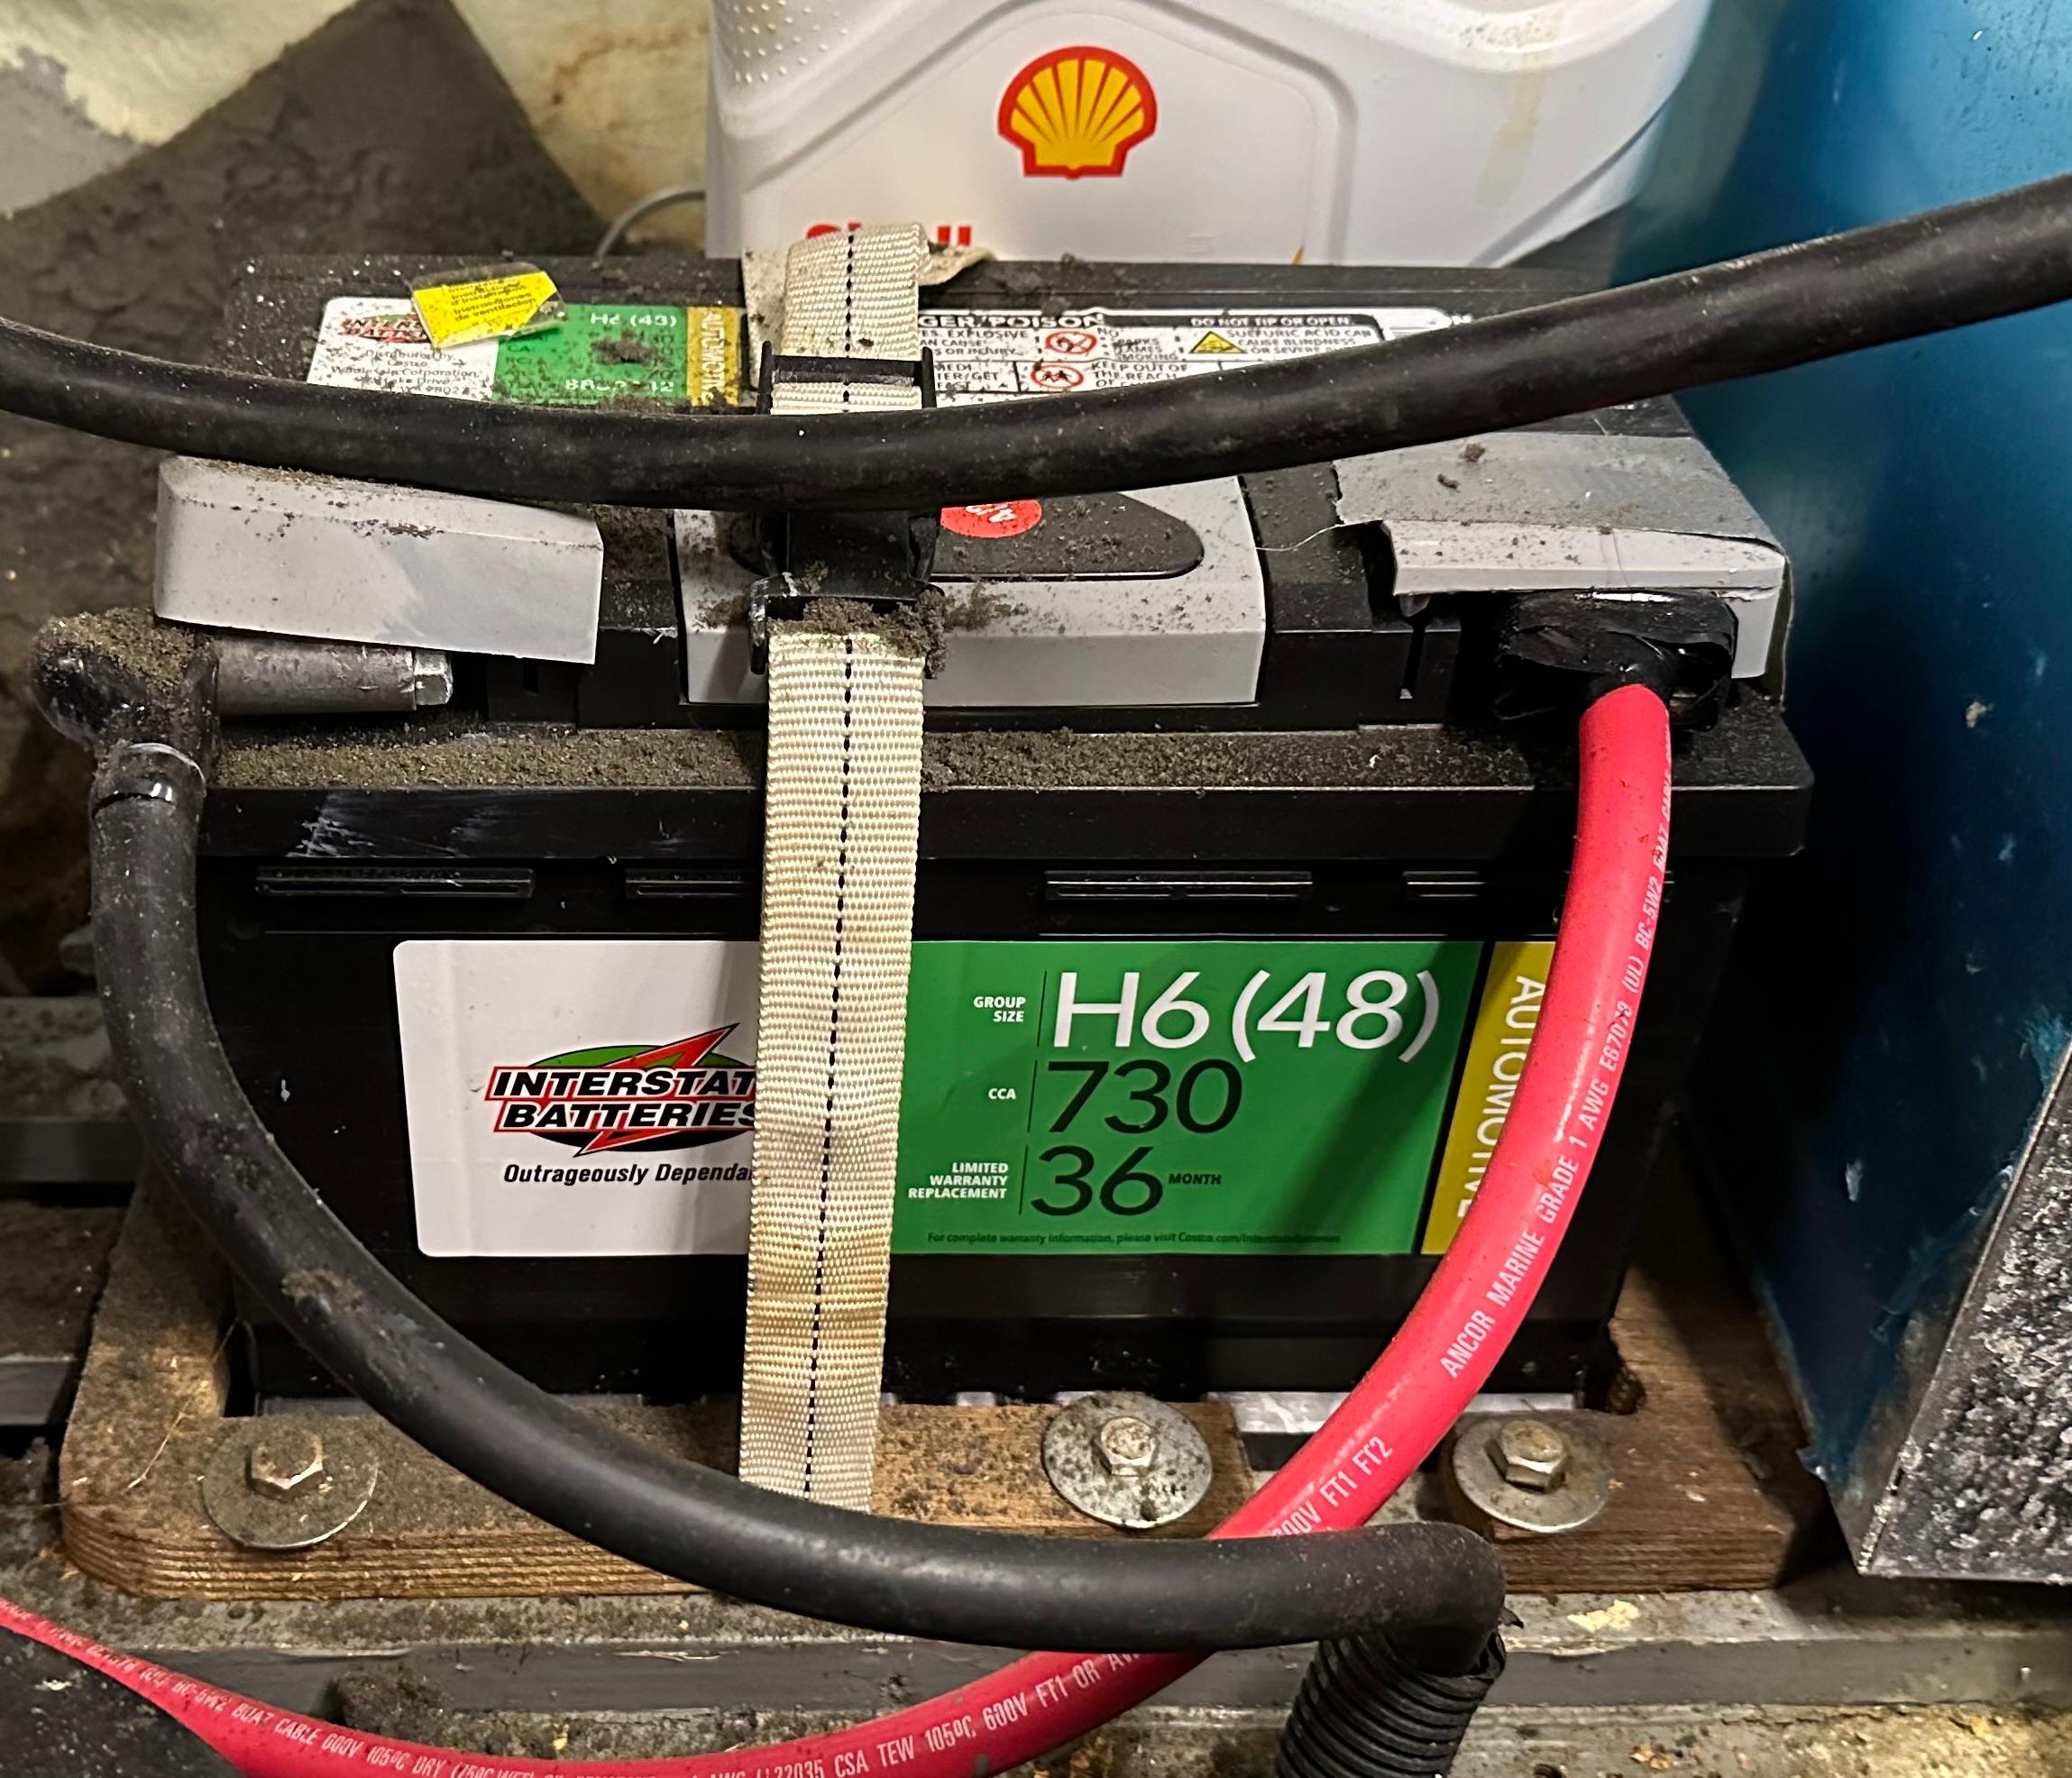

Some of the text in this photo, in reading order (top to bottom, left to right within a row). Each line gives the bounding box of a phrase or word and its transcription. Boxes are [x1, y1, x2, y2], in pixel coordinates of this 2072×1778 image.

[919, 314, 1105, 327] GER/POISON
[1191, 317, 1215, 326] DO
[1279, 317, 1304, 326] OR
[1306, 317, 1350, 326] OPEN
[1093, 371, 1120, 379] THE
[973, 996, 1027, 1009] GROUP
[993, 1011, 1025, 1022] SIZE
[1053, 970, 1440, 1062] H6 (48)
[493, 1071, 756, 1096] INTERSTAT
[988, 1088, 1017, 1100] CCA
[1047, 1059, 1243, 1134] 730
[504, 1163, 752, 1185] Outrageously Dependa
[952, 1163, 1008, 1173] LIMITED
[930, 1175, 1009, 1186] WARRANTY
[1031, 1145, 1222, 1215] 36 MONTH
[908, 1187, 1007, 1198] REPLACEMENT
[1272, 1500, 1322, 1536] 00V
[1319, 1472, 1357, 1508] FT1
[1352, 1436, 1394, 1476] FT2
[1440, 1310, 1496, 1379] ANCOR
[1486, 1229, 1545, 1308] MARINE
[1536, 1155, 1579, 1224] GRADE
[1568, 1134, 1588, 1149] 1
[1578, 1078, 1609, 1132] AWG
[1621, 955, 1644, 994] (UL)
[1635, 875, 1661, 950] BC-5W2
[928, 1233, 945, 1242] For
[948, 1233, 997, 1244] complete
[1116, 1232, 1151, 1244] please
[1154, 1232, 1176, 1242] visit
[835, 1749, 869, 1778] CSA
[876, 1735, 915, 1767] TEW
[982, 1691, 1029, 1731] 600V
[1035, 1675, 1069, 1709] FT1
[1072, 1658, 1101, 1689] OR
[274, 1718, 323, 1746] CABLE
